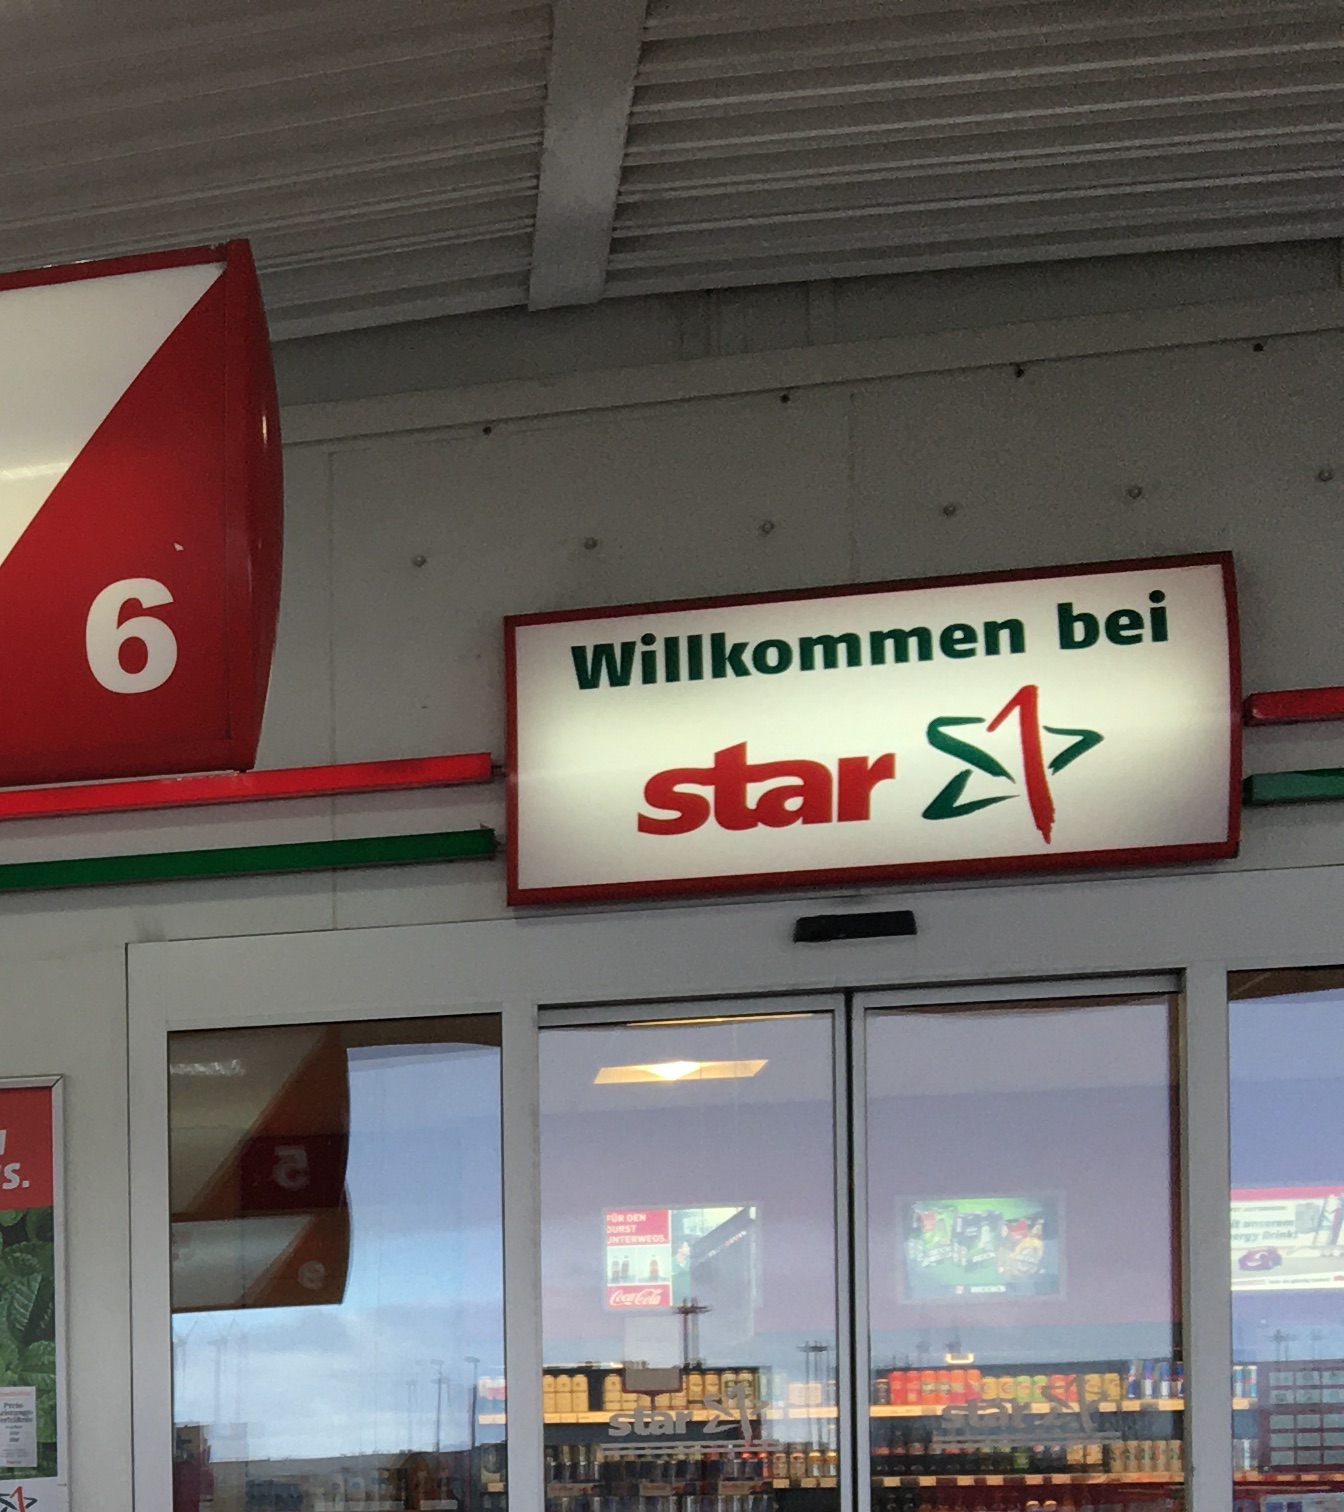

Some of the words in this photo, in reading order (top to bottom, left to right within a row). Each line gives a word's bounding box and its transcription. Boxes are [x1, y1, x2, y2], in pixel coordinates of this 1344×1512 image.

[85, 577, 178, 694] 6
[570, 611, 1028, 690] Willkommen
[1056, 589, 1170, 652] bei
[635, 740, 897, 837] star
[609, 1406, 694, 1437] star
[941, 1399, 1033, 1429] star
